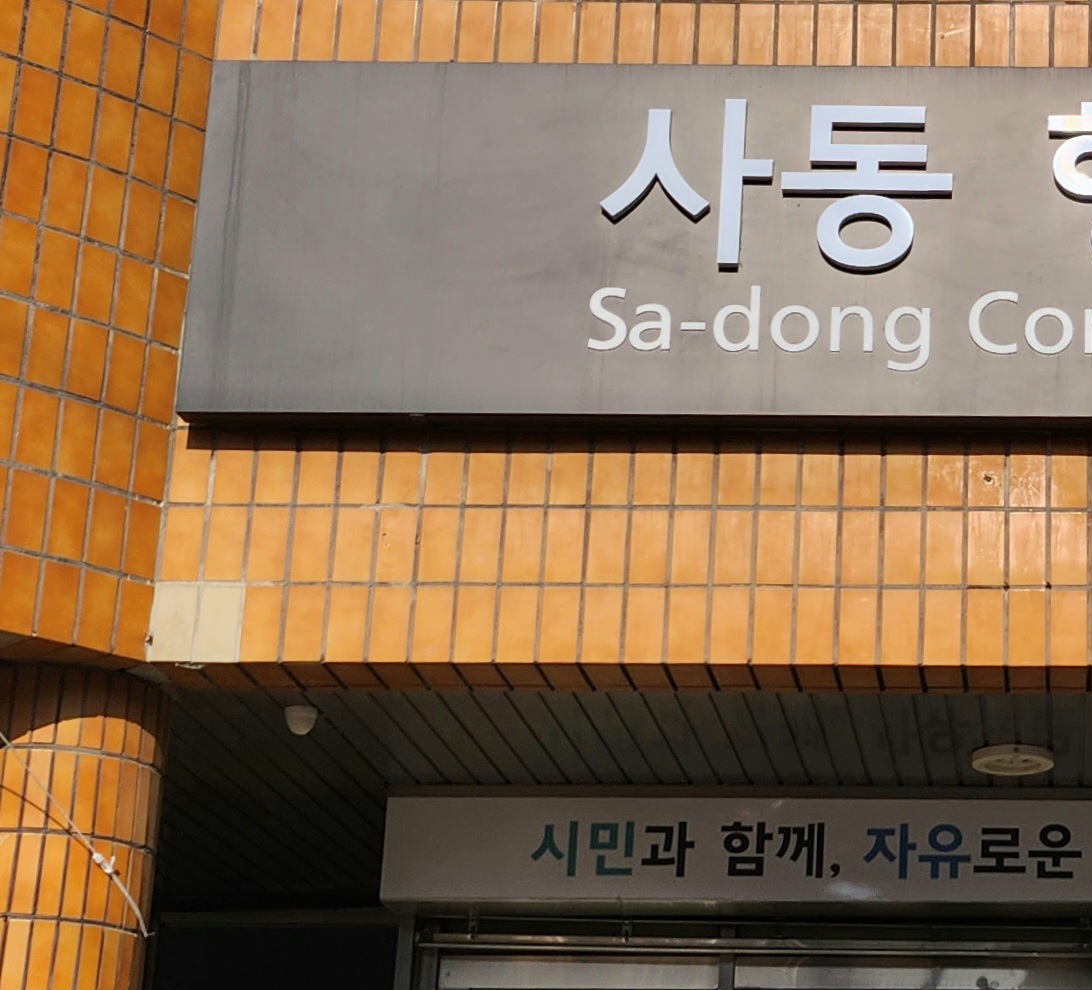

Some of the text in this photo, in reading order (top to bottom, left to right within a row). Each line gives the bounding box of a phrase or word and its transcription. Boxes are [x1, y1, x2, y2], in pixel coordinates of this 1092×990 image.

[600, 98, 953, 274] 사동
[588, 286, 932, 371] Sa-dong
[531, 820, 696, 878] 시민과
[721, 821, 841, 879] 함께,
[863, 823, 1083, 879] 자유로운
